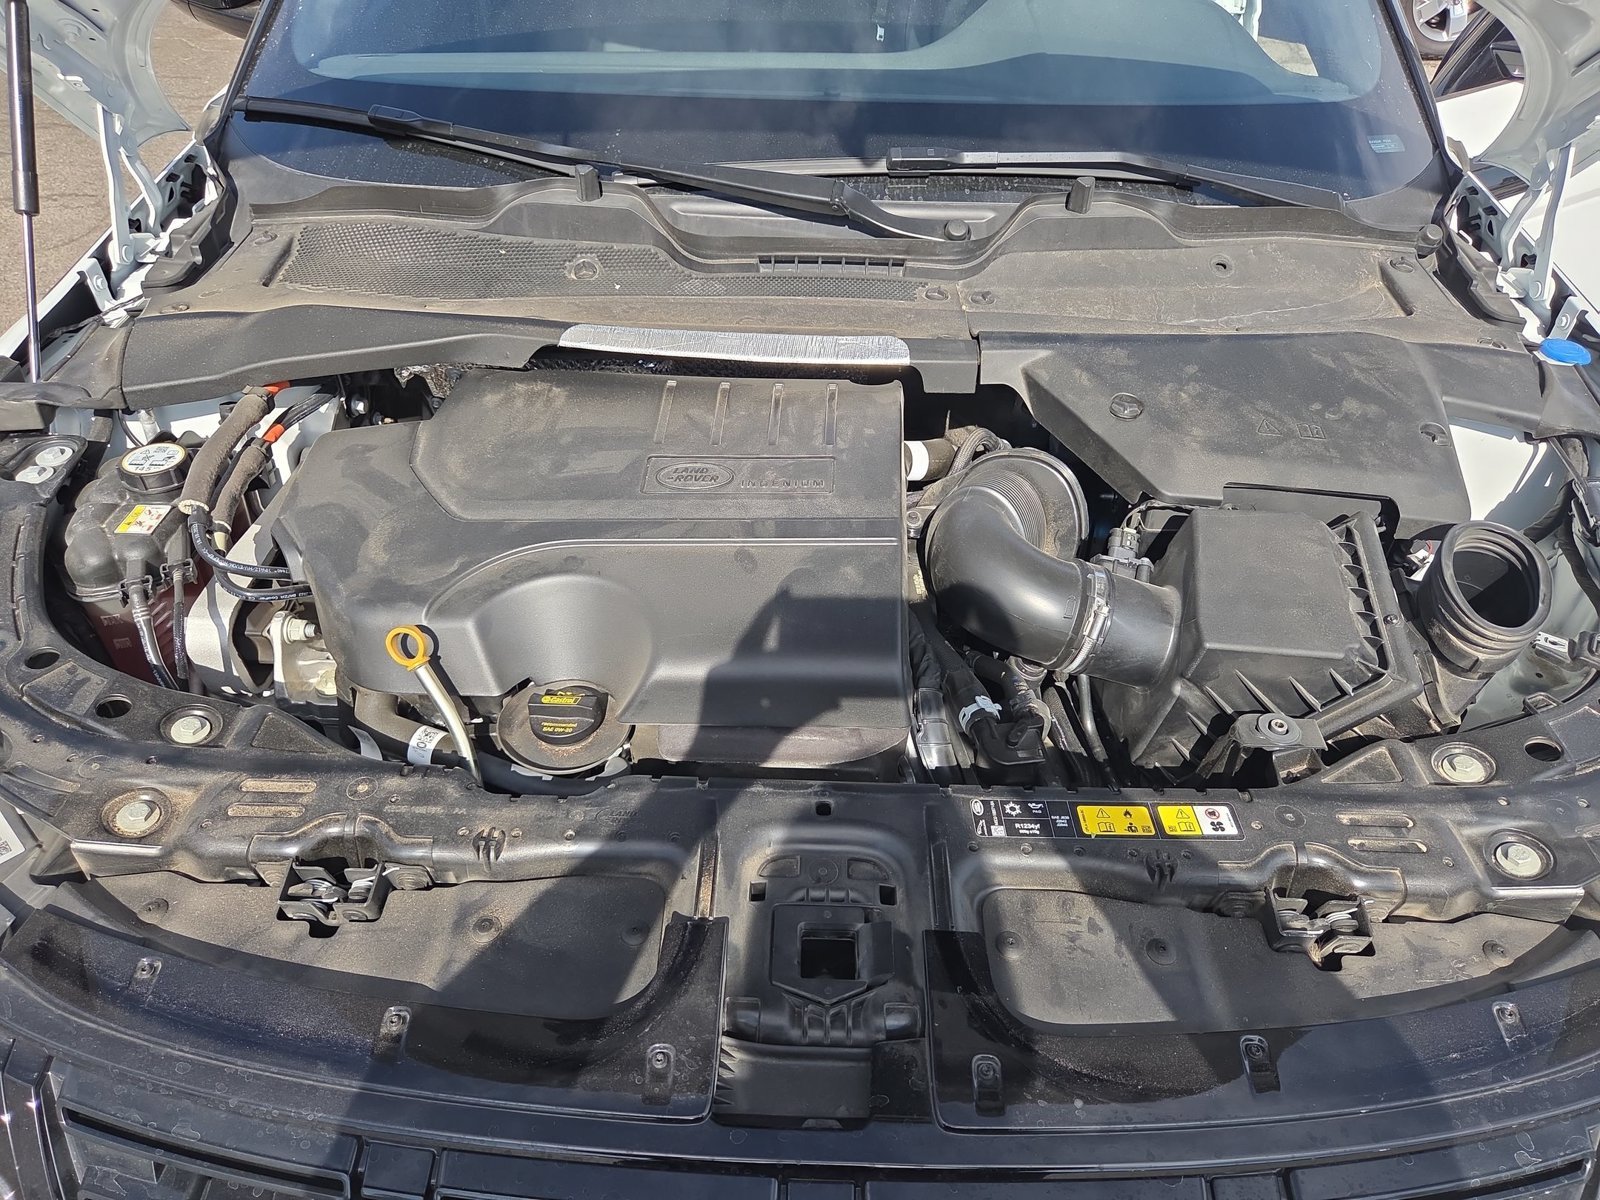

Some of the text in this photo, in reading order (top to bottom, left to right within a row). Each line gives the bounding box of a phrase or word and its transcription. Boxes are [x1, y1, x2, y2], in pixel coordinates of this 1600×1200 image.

[672, 467, 710, 475] LAND
[673, 475, 720, 483] ROVER
[740, 480, 825, 489] INGENIUM
